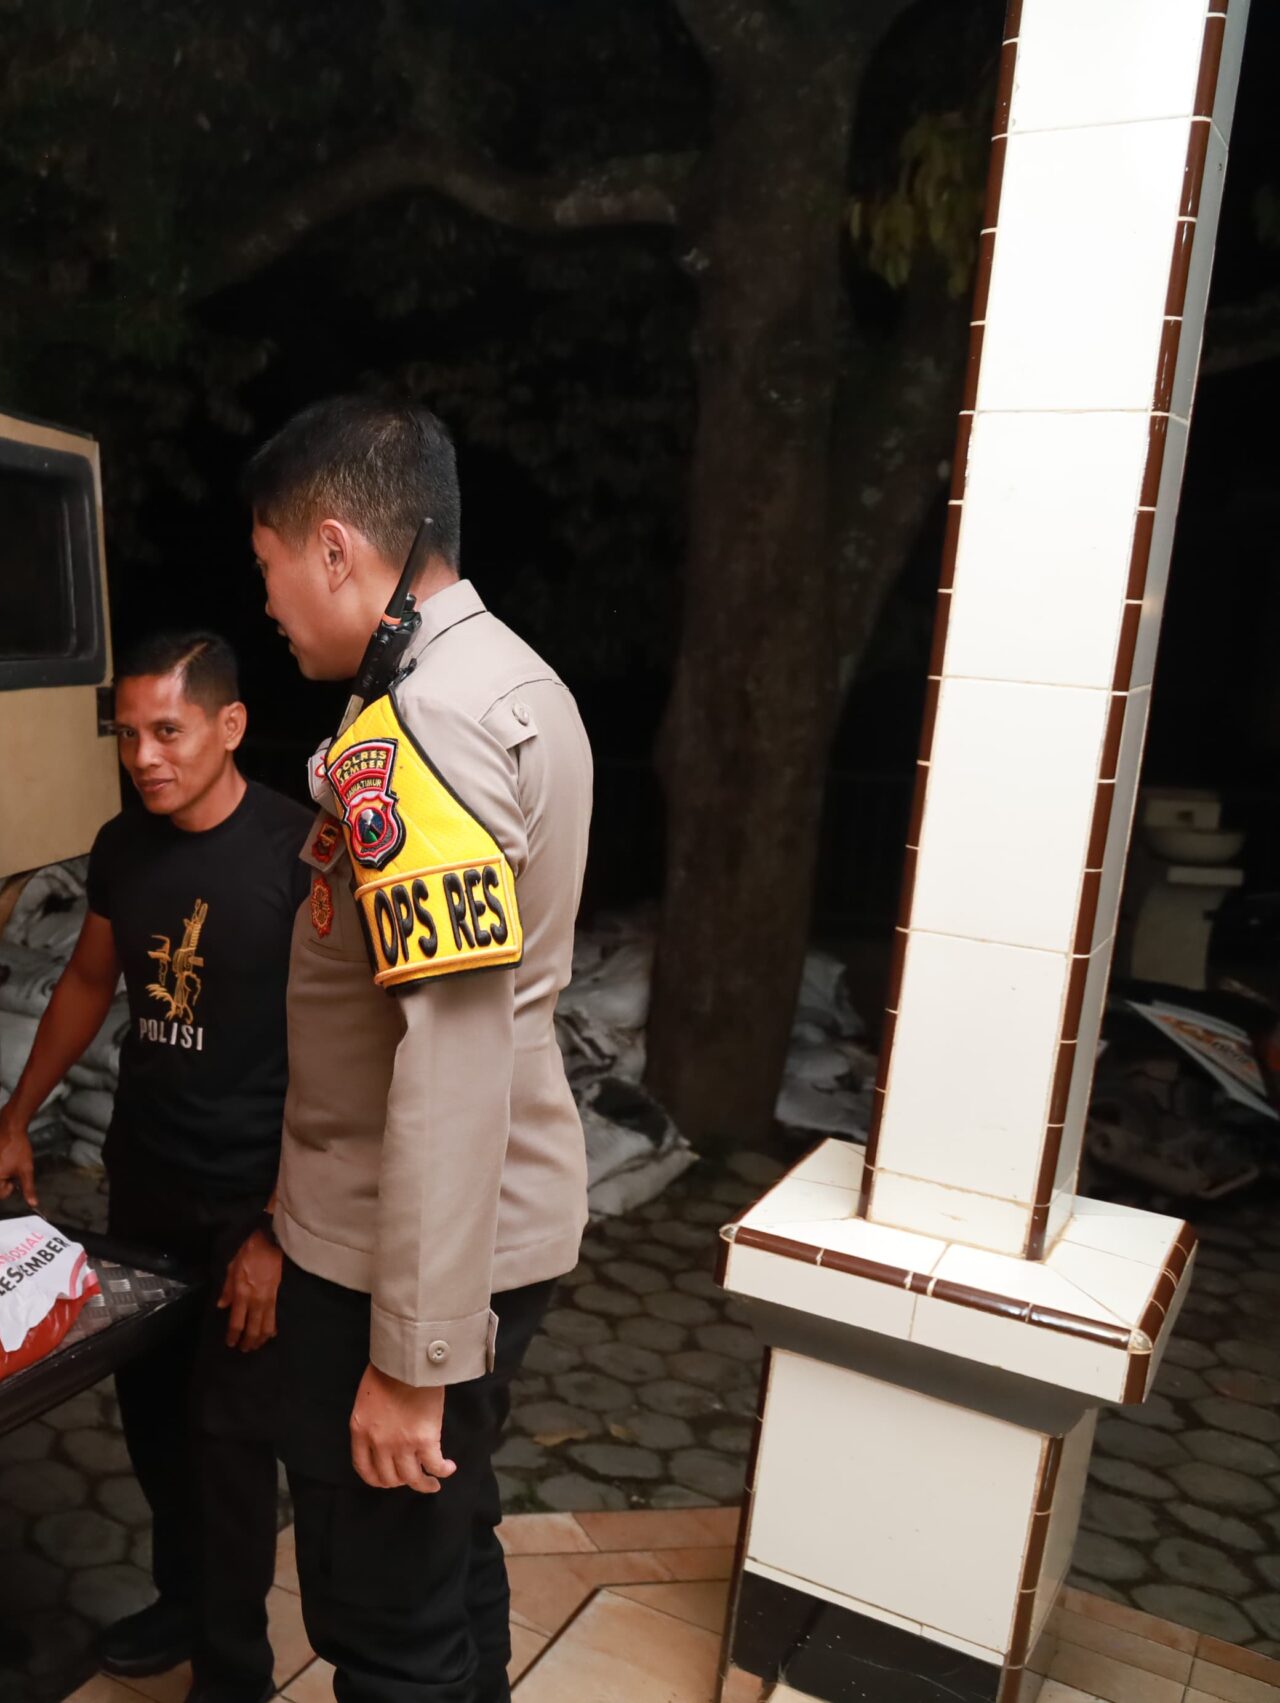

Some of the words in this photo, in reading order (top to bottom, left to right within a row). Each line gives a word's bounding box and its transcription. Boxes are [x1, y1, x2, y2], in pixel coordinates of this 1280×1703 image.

[335, 750, 387, 778] POLRES
[338, 760, 384, 785] JEMBER
[374, 879, 438, 967] OPS
[442, 865, 508, 951] RES
[139, 1018, 204, 1051] POLISI
